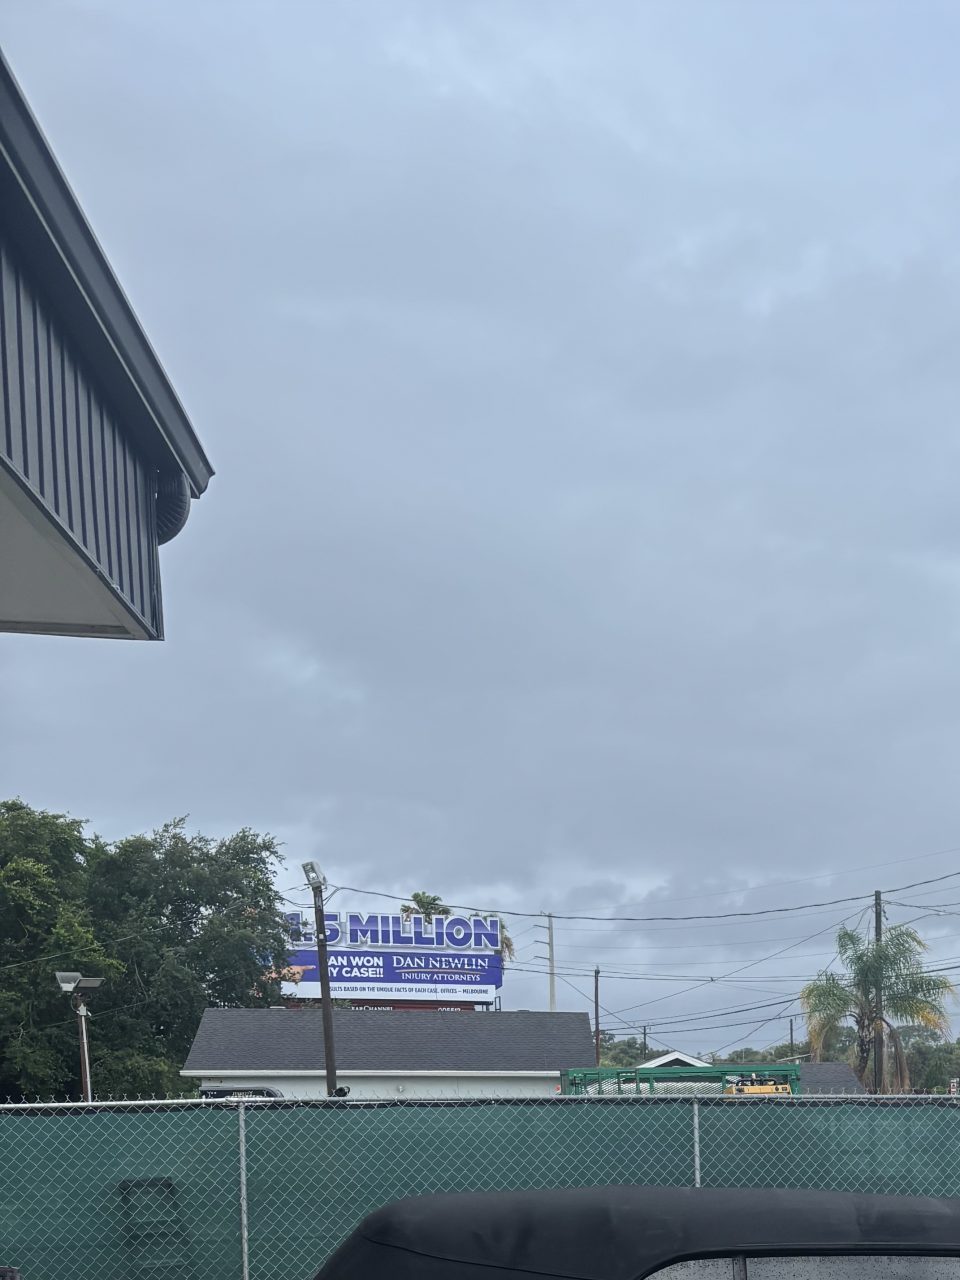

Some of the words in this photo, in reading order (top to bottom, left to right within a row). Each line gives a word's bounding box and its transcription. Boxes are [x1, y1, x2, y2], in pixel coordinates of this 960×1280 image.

[347, 912, 500, 949] MILLION
[328, 956, 347, 966] AN
[350, 956, 383, 967] WON
[392, 956, 425, 968] DAN
[429, 957, 488, 969] NEWLIN
[342, 968, 384, 978] CASE!!
